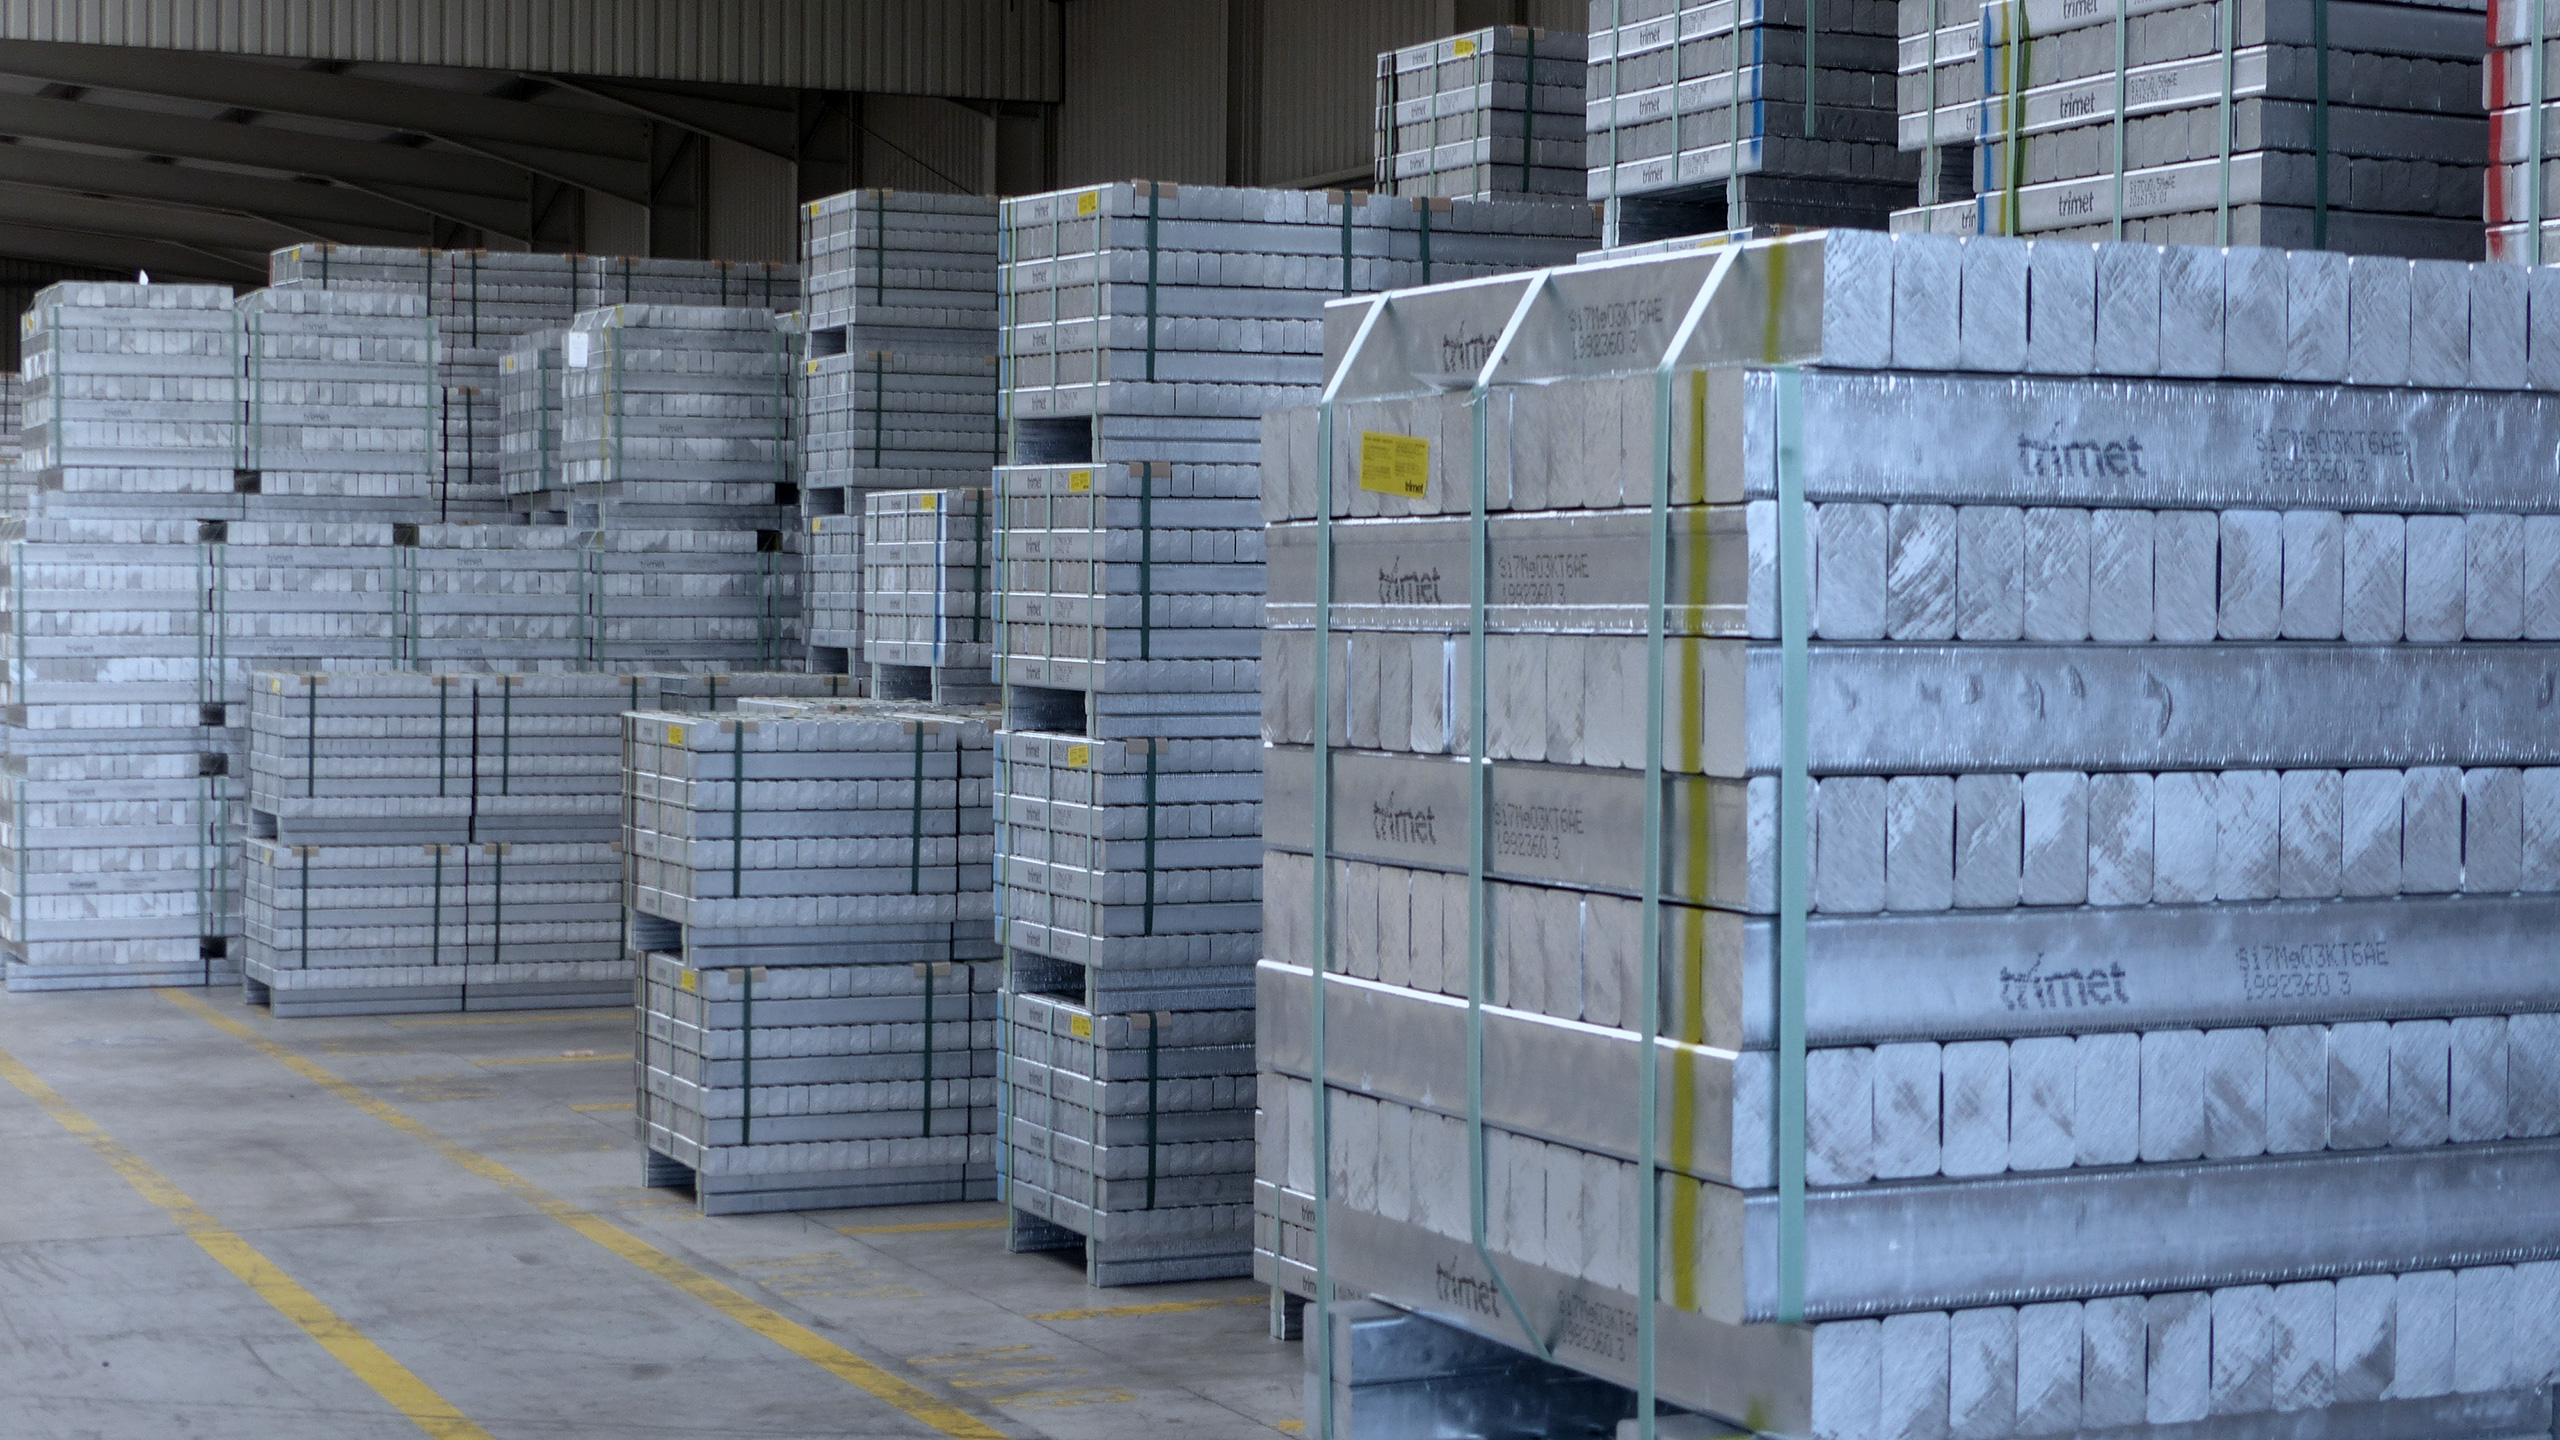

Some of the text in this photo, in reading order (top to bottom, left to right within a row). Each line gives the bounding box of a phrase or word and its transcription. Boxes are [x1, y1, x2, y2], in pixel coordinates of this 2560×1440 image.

[1639, 27, 1660, 46] trimet
[1639, 97, 1660, 116] trimet
[2060, 92, 2095, 118] trimet
[1642, 167, 1663, 184] trimet
[2059, 191, 2094, 216] trimet
[1572, 330, 1638, 360] 1992360 3
[2017, 421, 2147, 479] trimet
[2261, 457, 2368, 483] 1992360 3
[1404, 479, 1424, 494] trimet
[1378, 554, 1443, 605] trimet
[1502, 581, 1566, 605] 1992360 3
[1373, 790, 1437, 845] trimet
[1497, 828, 1562, 860] 1992360 3
[2000, 951, 2130, 1011] trimet
[2243, 970, 2351, 1001] 1992360 3
[1436, 1254, 1500, 1318] trimet
[1617, 1337, 1626, 1362] 3
